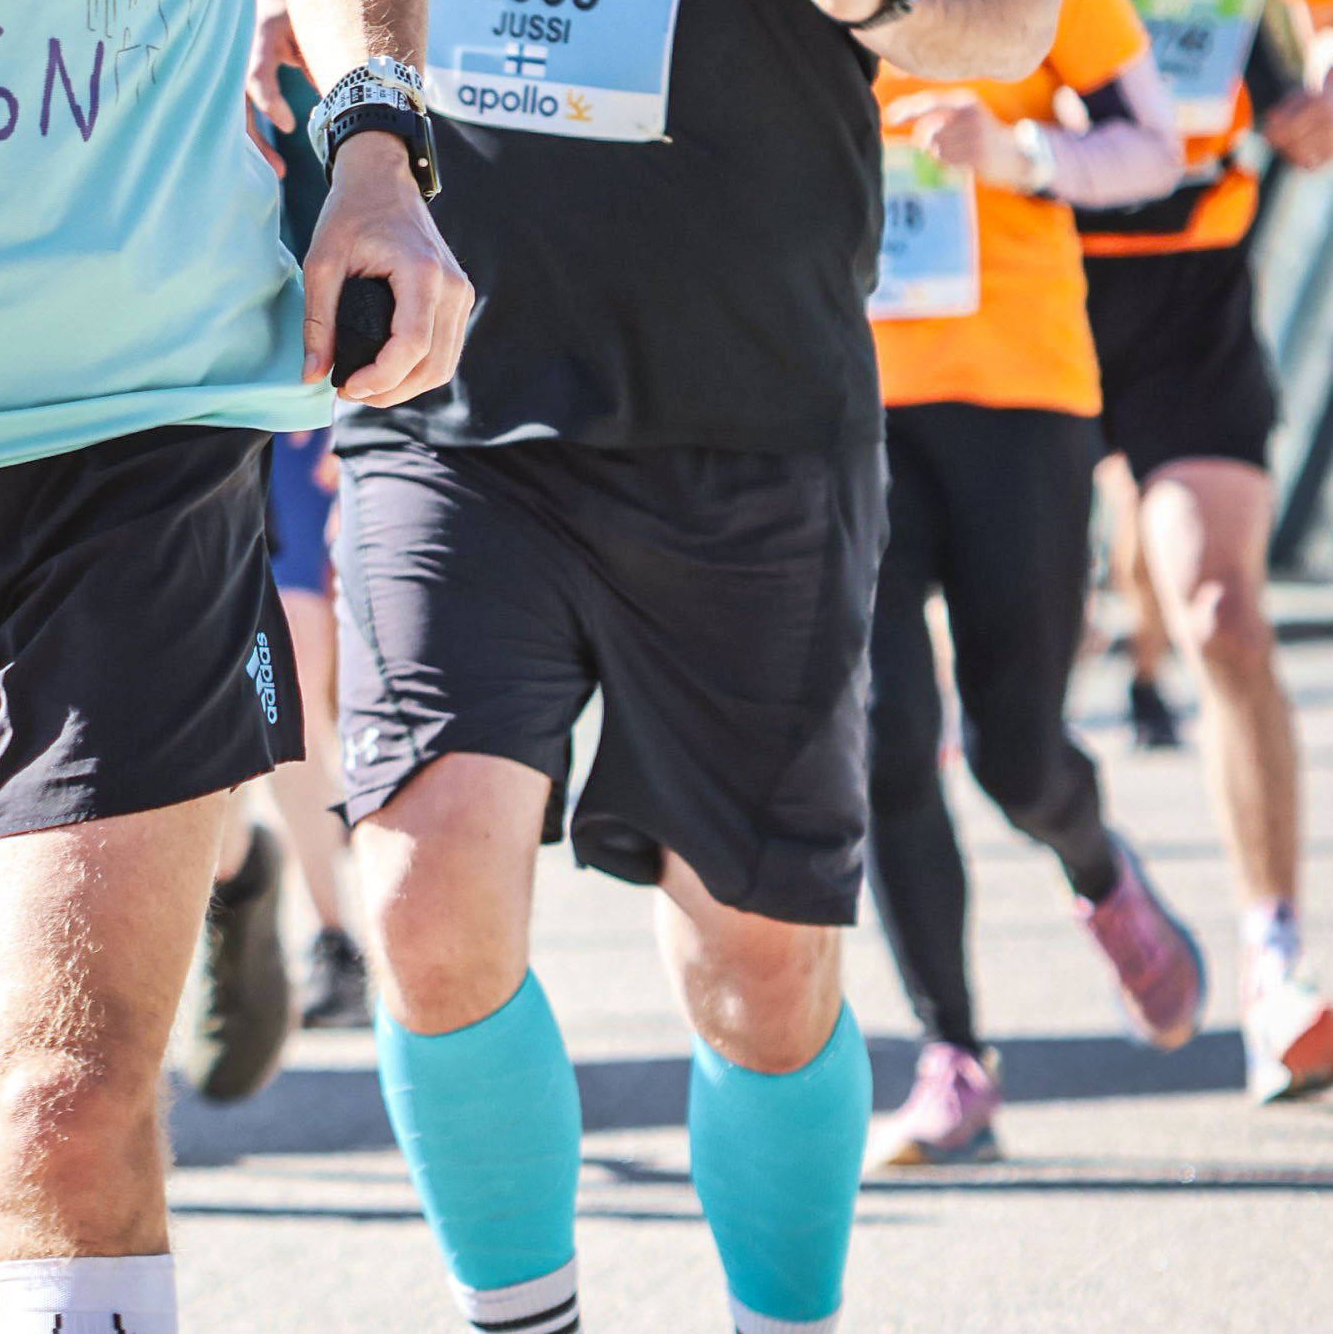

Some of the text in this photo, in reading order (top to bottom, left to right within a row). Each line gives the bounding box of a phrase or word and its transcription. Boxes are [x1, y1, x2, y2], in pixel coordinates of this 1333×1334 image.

[492, 11, 571, 44] JUSSI
[457, 84, 559, 117] apollo
[256, 632, 278, 725] adidas
